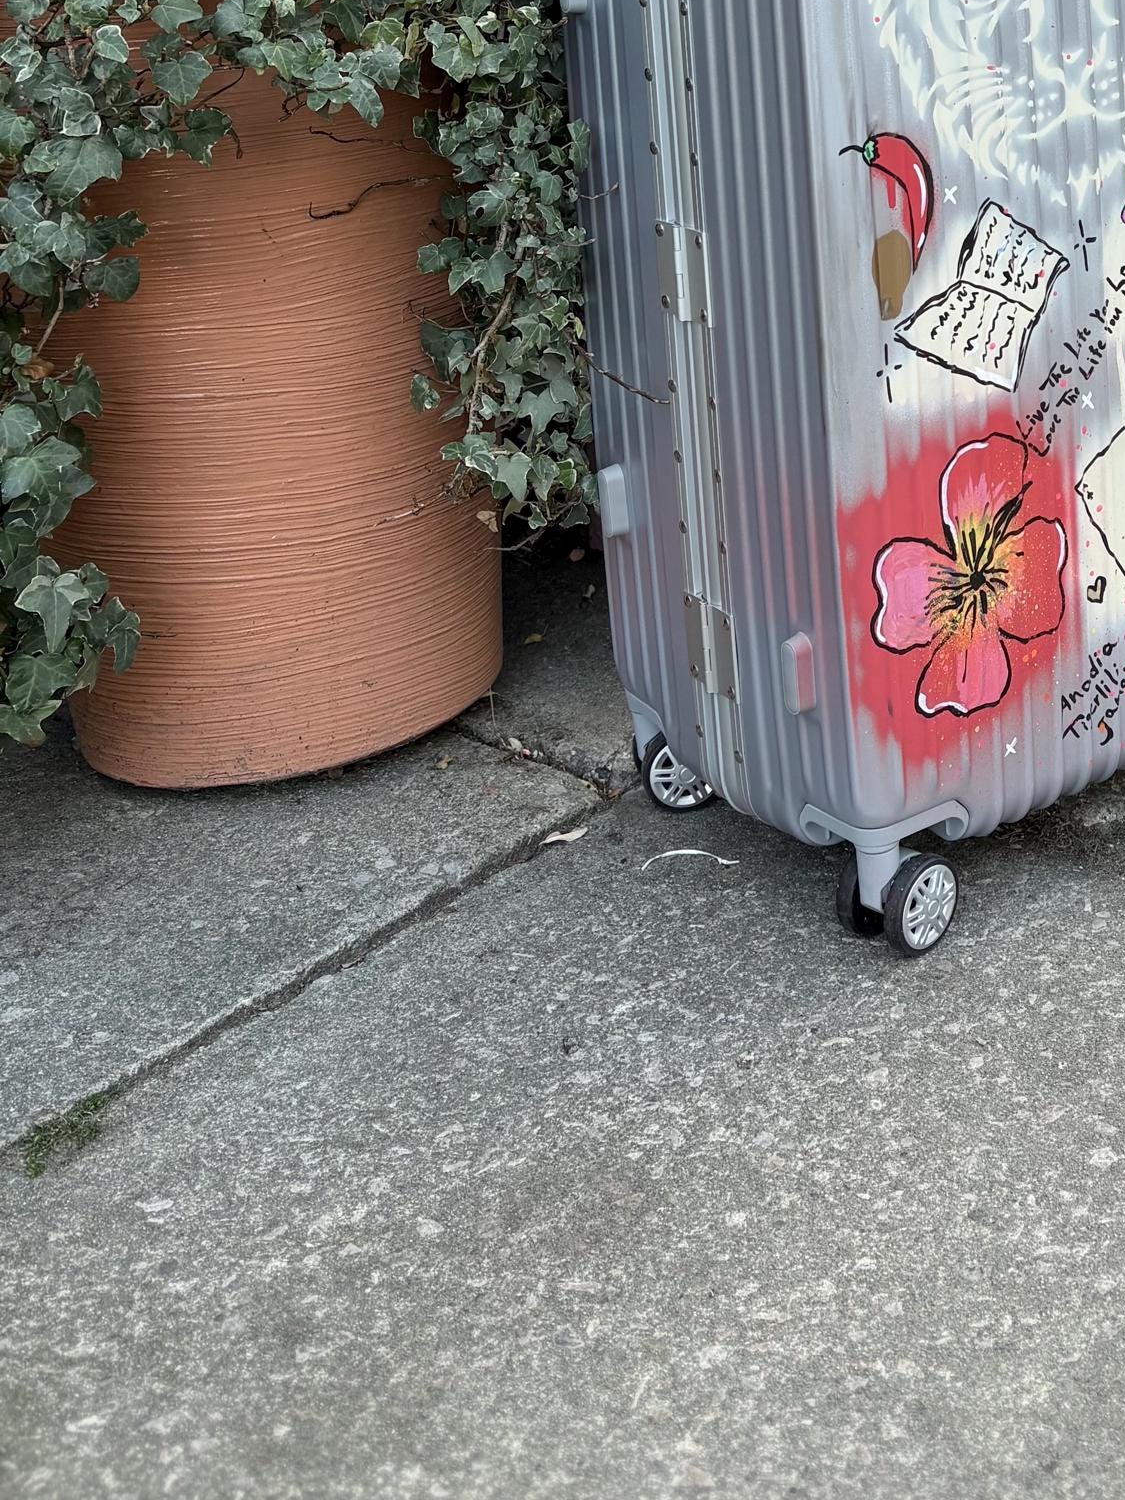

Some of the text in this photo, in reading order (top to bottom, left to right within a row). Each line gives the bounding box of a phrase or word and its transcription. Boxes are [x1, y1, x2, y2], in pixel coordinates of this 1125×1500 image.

[1016, 401, 1050, 440] Live
[1038, 361, 1072, 390] The
[1028, 414, 1061, 457] Love
[1078, 340, 1107, 380] Life
